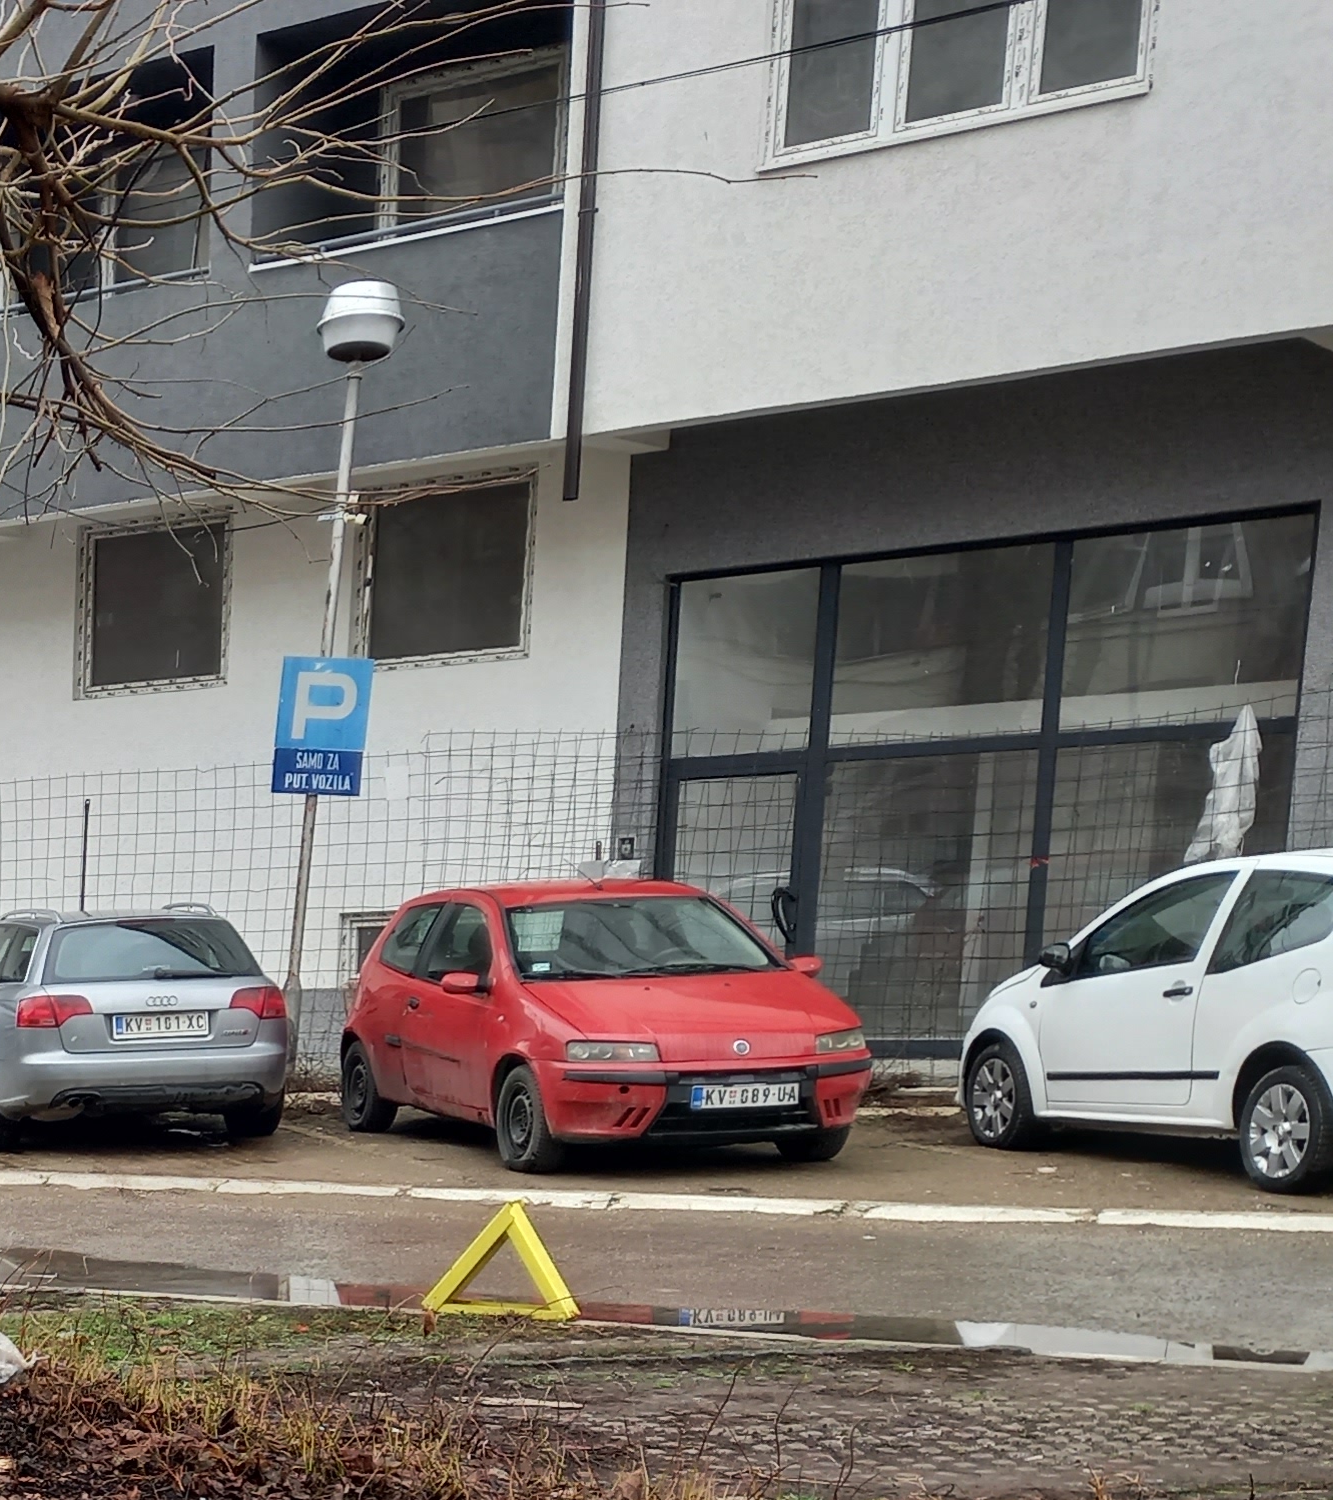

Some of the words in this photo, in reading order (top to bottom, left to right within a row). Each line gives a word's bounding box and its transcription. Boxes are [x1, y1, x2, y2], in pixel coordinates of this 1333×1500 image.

[291, 671, 358, 739] P
[296, 752, 324, 769] SAMO
[327, 754, 340, 770] ZA
[311, 774, 351, 791] VOZILA
[125, 1016, 143, 1032] KV
[705, 1089, 727, 1105] KV
